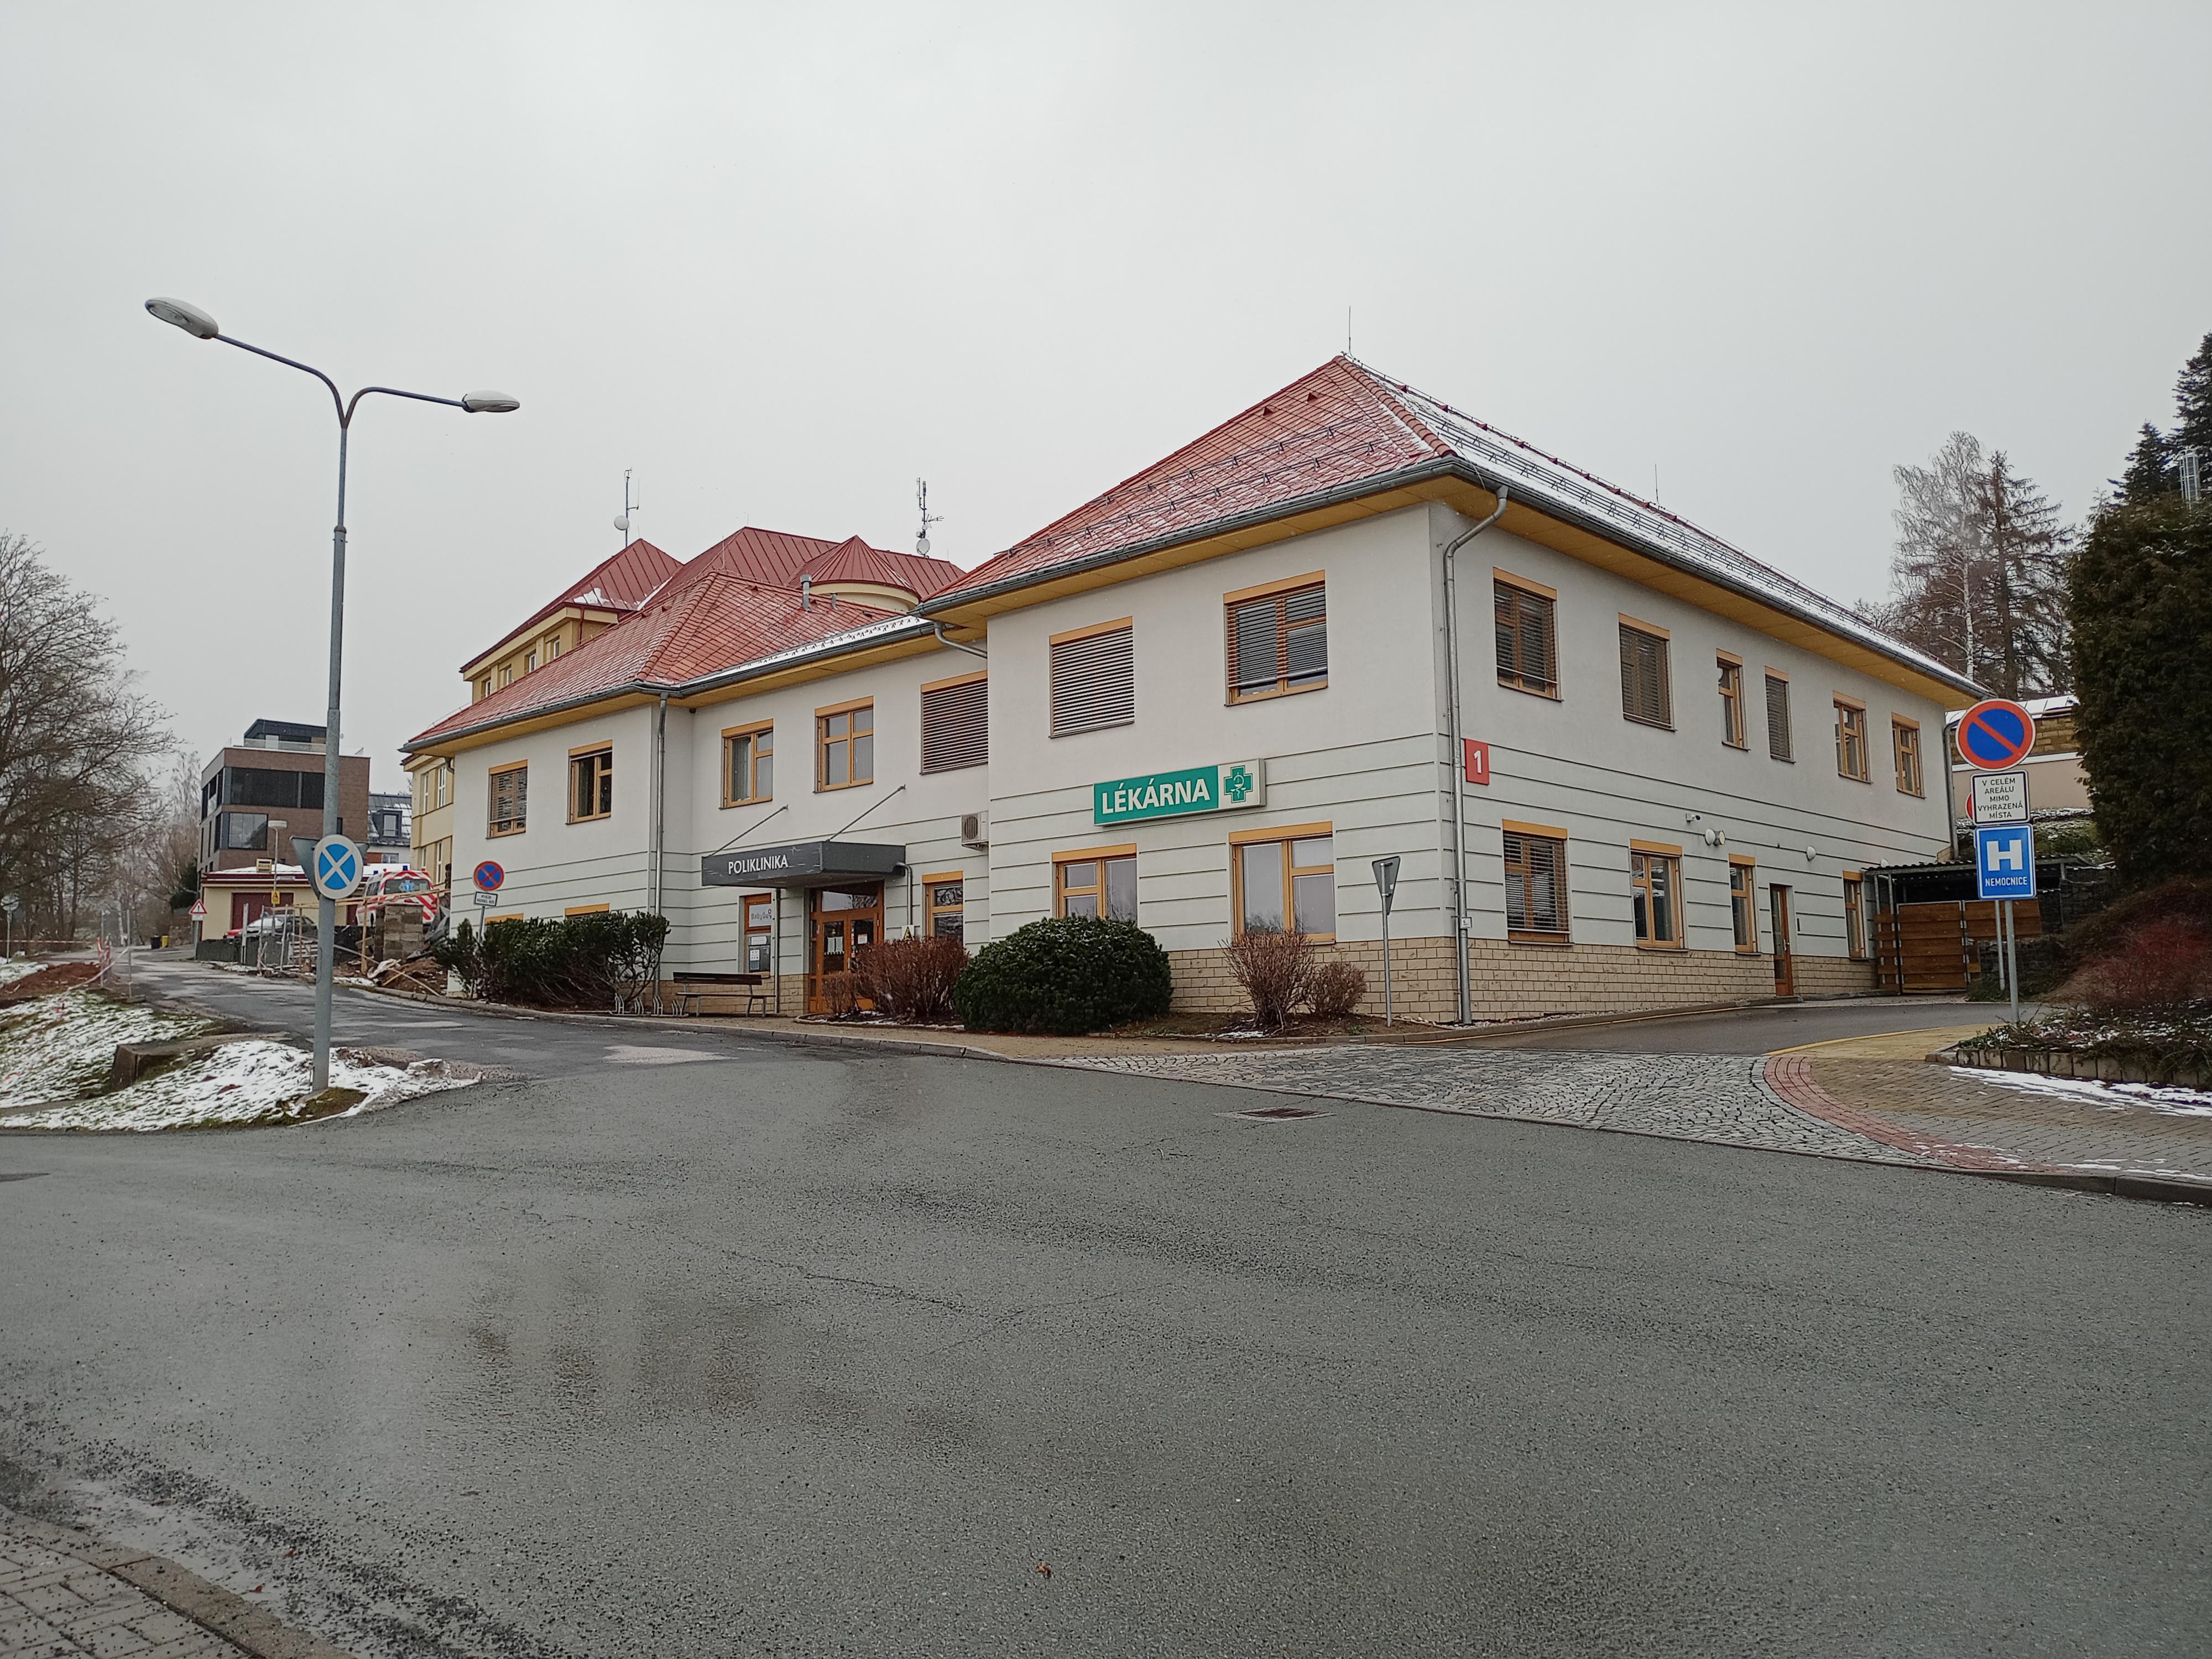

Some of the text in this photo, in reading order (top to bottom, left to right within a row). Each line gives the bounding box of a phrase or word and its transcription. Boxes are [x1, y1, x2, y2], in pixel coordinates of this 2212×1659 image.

[1473, 750, 1482, 774] 1
[1990, 776, 2016, 786] CELÉM
[1984, 785, 2014, 795] AREÁLU
[1102, 778, 1211, 815] LÉKÁRNA
[1978, 800, 2023, 812] VYHRAZENÁ
[1989, 811, 2012, 819] MÍSTA
[1986, 839, 2023, 872] H
[728, 854, 789, 875] POLIKLINIKA
[1985, 876, 2028, 887] NEMOCNICE
